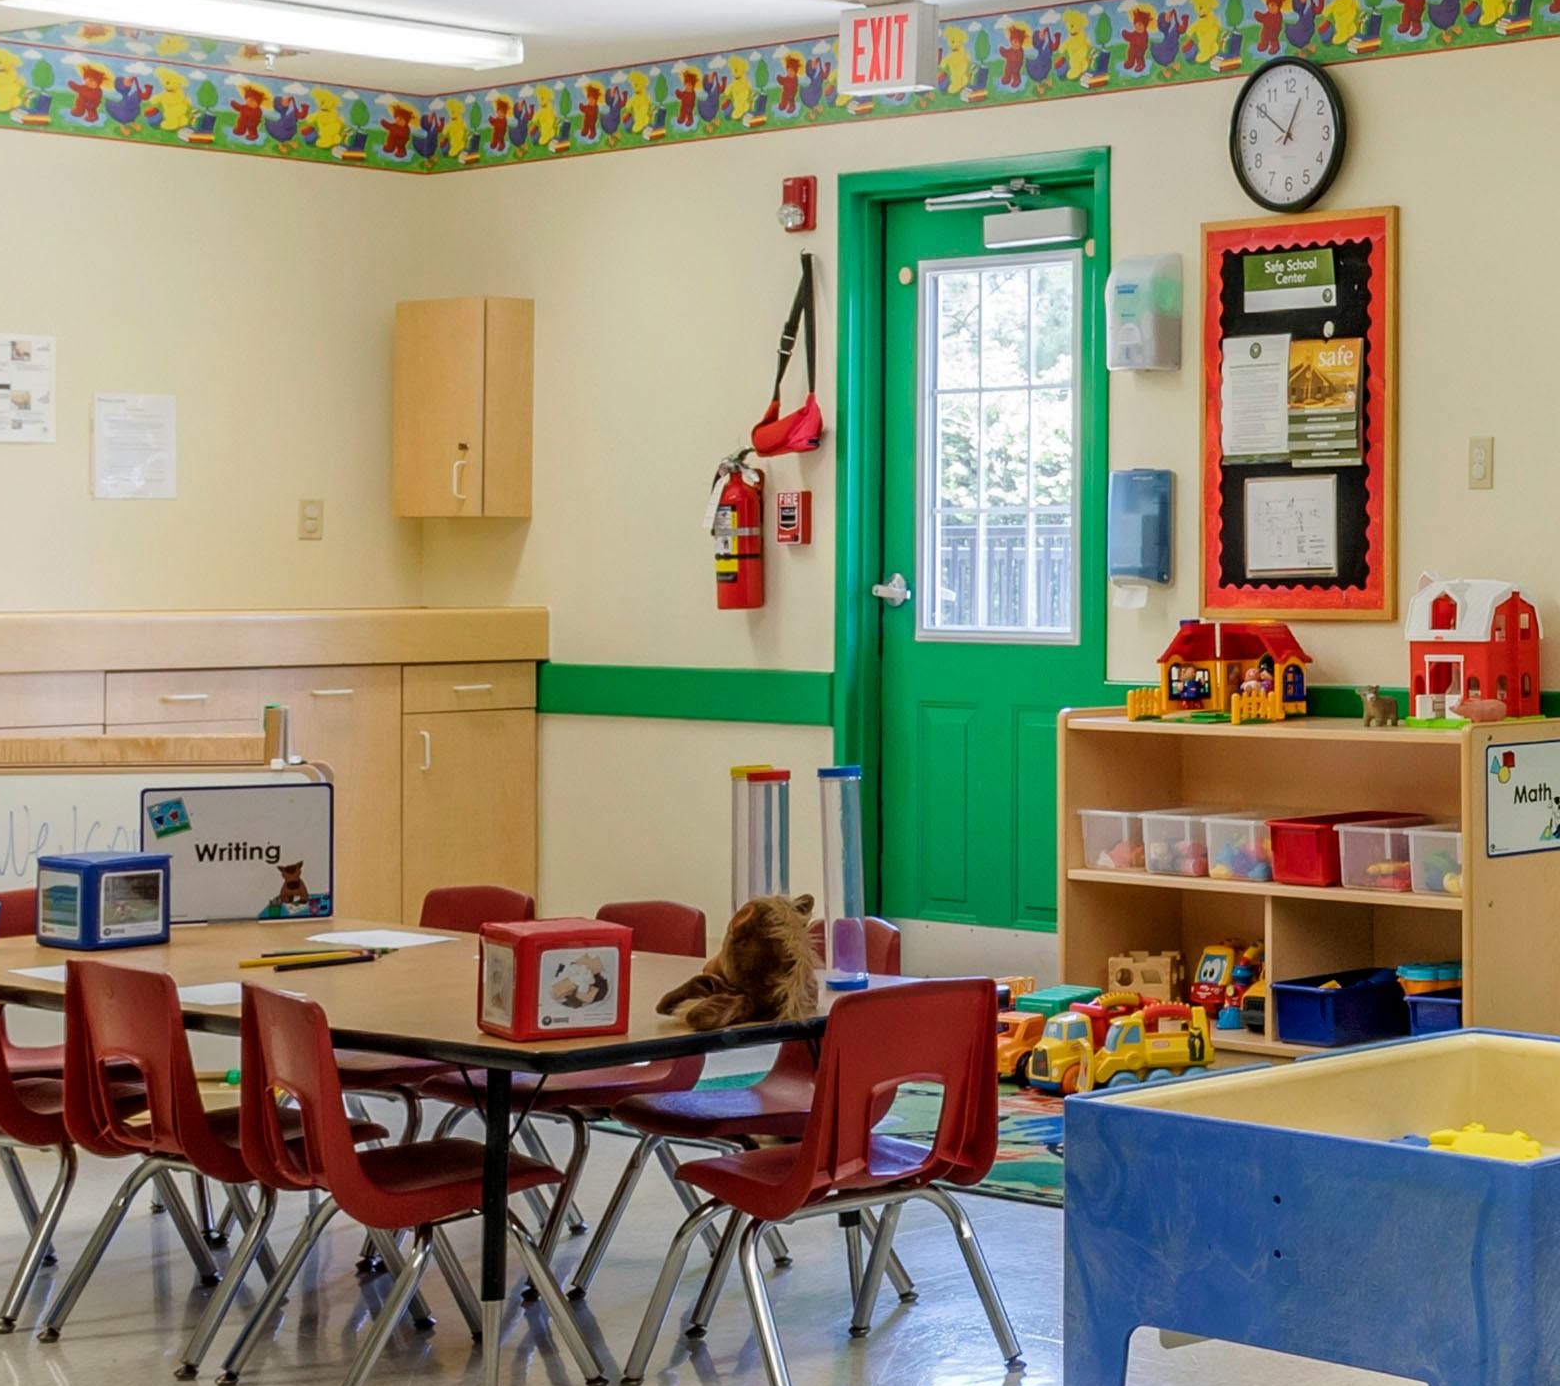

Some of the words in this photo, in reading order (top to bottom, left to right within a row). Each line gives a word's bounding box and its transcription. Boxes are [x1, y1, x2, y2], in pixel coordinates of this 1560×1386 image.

[852, 14, 908, 83] EXIT
[1285, 78, 1297, 93] 12
[1305, 86, 1309, 99] 1
[1268, 88, 1278, 102] 11
[1317, 100, 1325, 115] 2
[1249, 129, 1257, 145] 9
[1322, 125, 1330, 140] 3
[1255, 153, 1262, 168] 8
[1316, 151, 1324, 165] 4
[1268, 171, 1276, 185] 7
[1285, 176, 1293, 192] 6
[1302, 169, 1310, 184] 5
[1264, 260, 1284, 274] Safe
[1287, 256, 1317, 271] School
[1275, 273, 1307, 284] Center
[1319, 346, 1353, 366] safe
[779, 493, 798, 505] FIRE
[1514, 782, 1552, 804] Math
[195, 842, 281, 864] Writing
